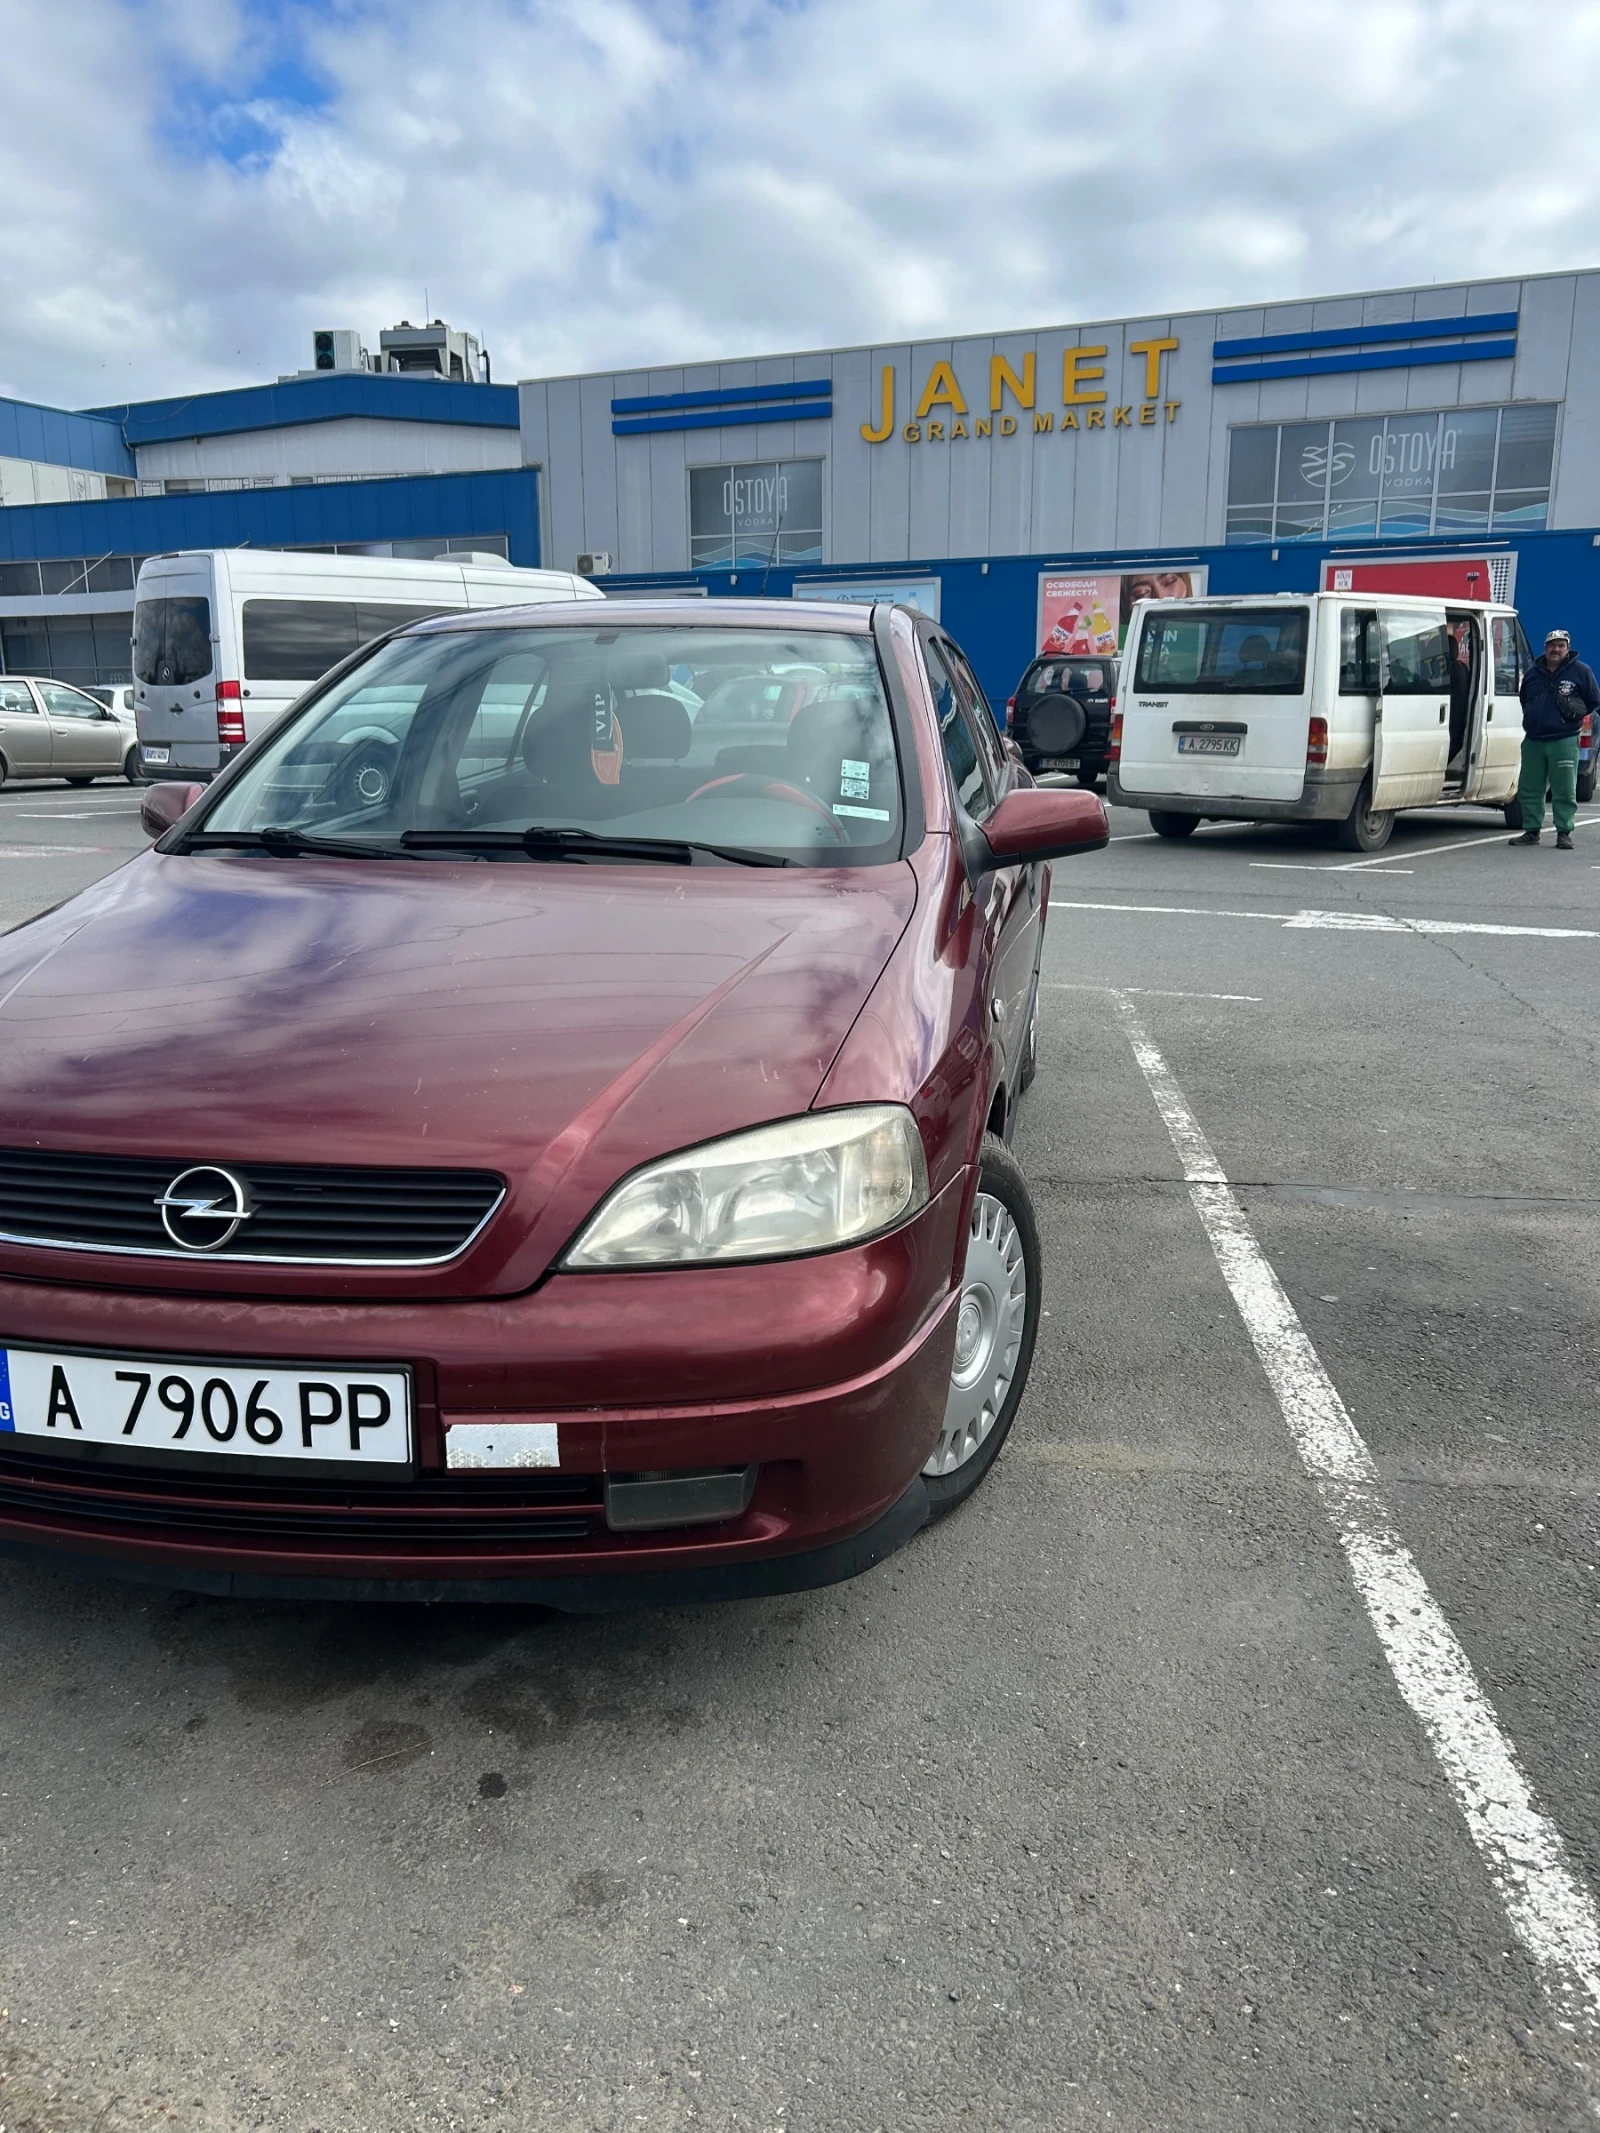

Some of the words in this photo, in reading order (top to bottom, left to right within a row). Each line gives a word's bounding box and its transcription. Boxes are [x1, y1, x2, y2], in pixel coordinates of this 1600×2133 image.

[860, 338, 1179, 443] JANET
[903, 415, 1017, 443] GRAND
[1033, 402, 1181, 433] MARKET
[1368, 429, 1457, 475] OSTOYA
[723, 476, 788, 516] OSTOYA
[1383, 476, 1433, 488] VODKA
[737, 517, 774, 527] VODKA
[1046, 580, 1097, 589] ОСВОБОДИ
[1046, 589, 1099, 598] СВЕЖЕСТТА
[595, 693, 607, 733] VIP
[1188, 738, 1195, 749] A
[0, 1401, 11, 1420] G
[46, 1364, 83, 1430] A
